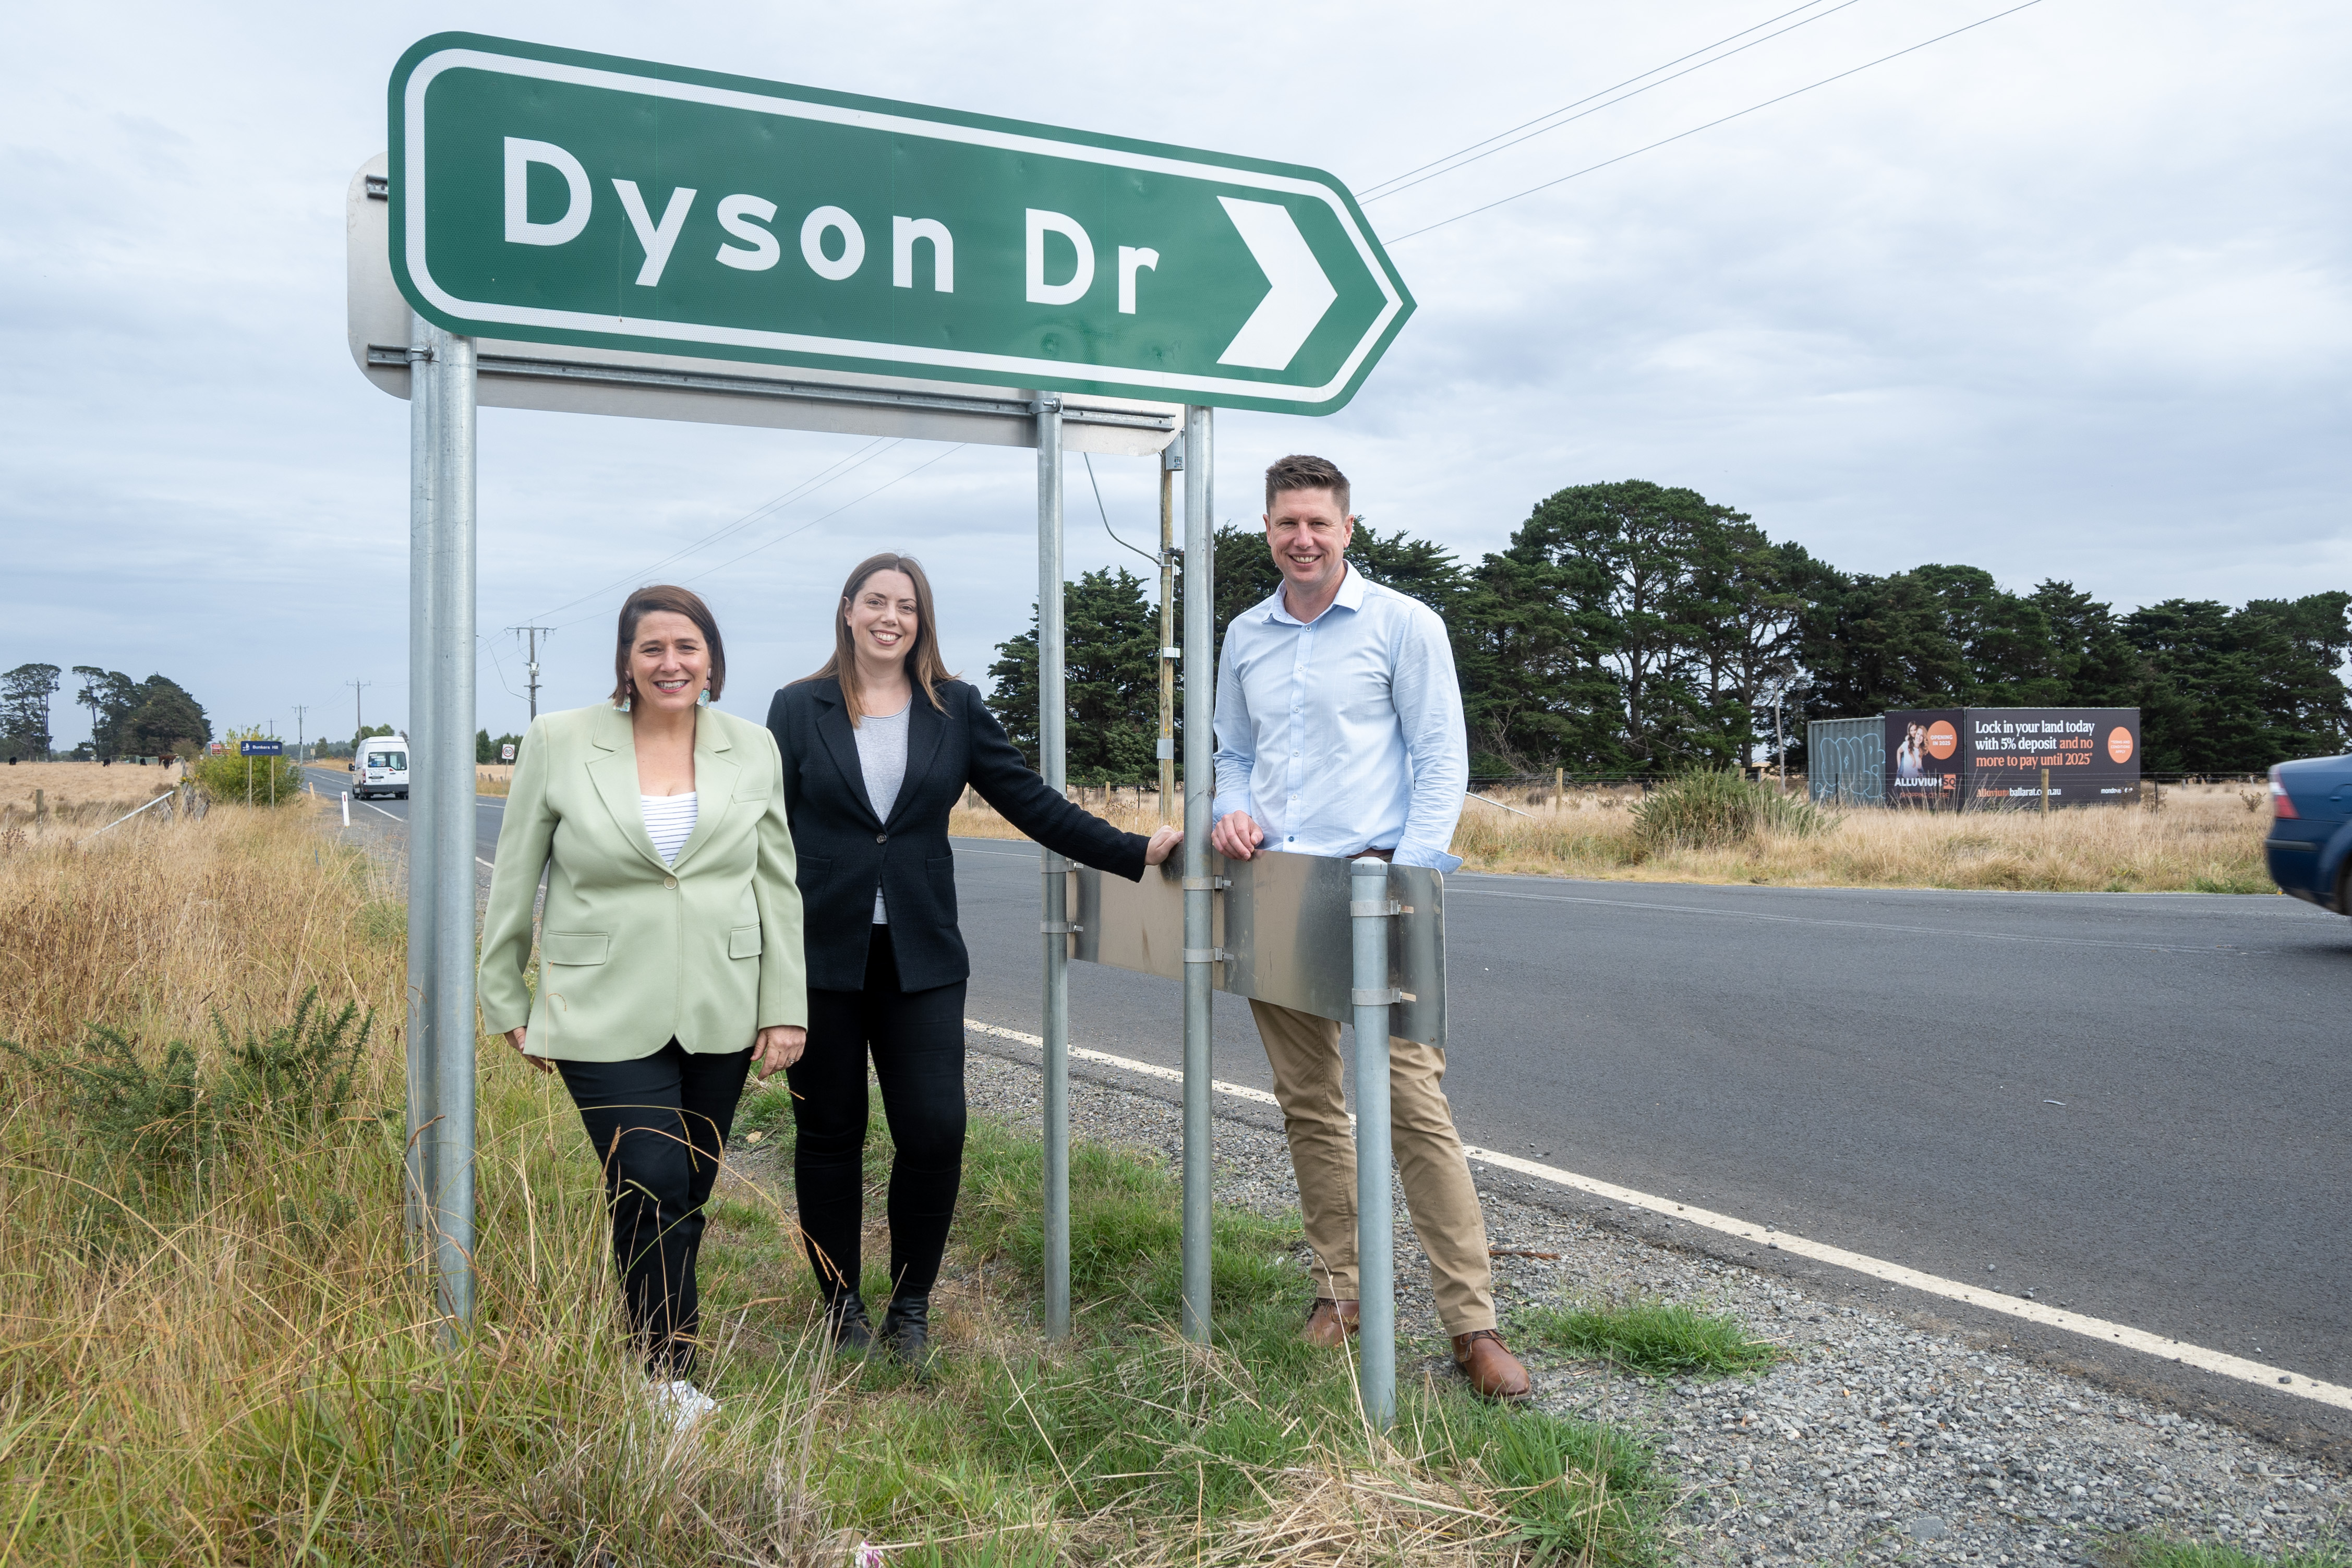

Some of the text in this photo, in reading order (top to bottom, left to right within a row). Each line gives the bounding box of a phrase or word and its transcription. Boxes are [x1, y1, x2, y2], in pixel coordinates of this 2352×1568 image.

[503, 136, 1161, 316] Dyson Dr
[1975, 720, 2095, 737] Lock in your land today
[1975, 736, 2093, 753] with 5% deposit and no
[1976, 757, 2005, 767] more
[2007, 755, 2018, 766] to
[2020, 756, 2039, 770] pay
[2041, 753, 2063, 766] until
[1894, 778, 1956, 788] ALLUVIUM SQ
